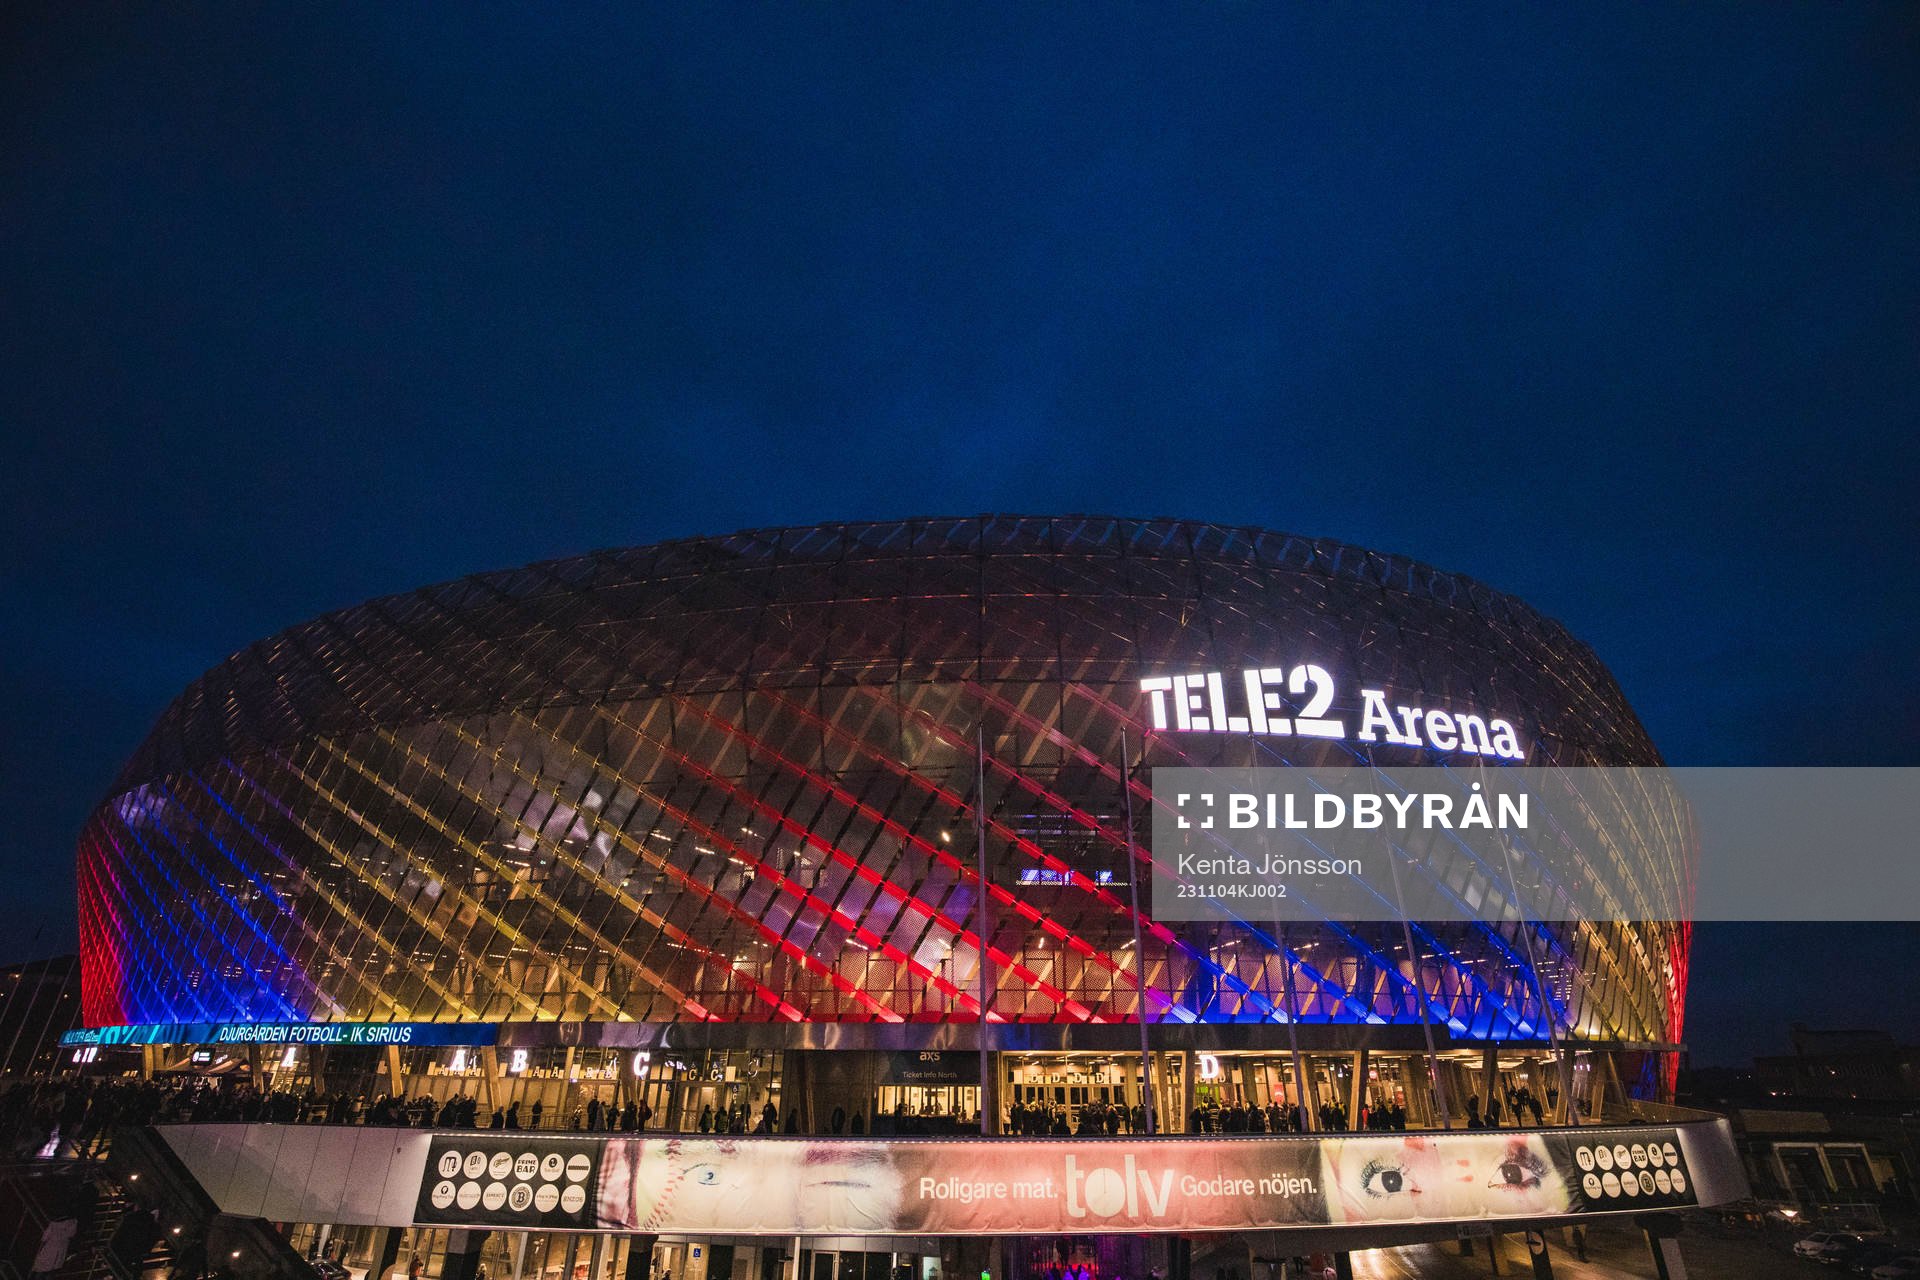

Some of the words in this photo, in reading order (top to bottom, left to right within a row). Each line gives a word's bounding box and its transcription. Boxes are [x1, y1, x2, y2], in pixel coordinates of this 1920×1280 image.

[1141, 664, 1345, 739] TELE2
[1358, 689, 1524, 760] Arena
[219, 1024, 292, 1042] DJURGÅRDEN
[350, 1026, 366, 1042] IK
[366, 1026, 412, 1043] SIRIUS
[449, 1049, 466, 1072] A
[510, 1049, 528, 1073] B
[633, 1051, 651, 1077] C
[919, 1051, 941, 1062] axs
[1199, 1054, 1220, 1079] D
[903, 1071, 921, 1079] Ticket
[923, 1071, 937, 1079] Info
[938, 1071, 958, 1079] North
[516, 1165, 536, 1174] BAR
[919, 1176, 1008, 1204] Roligare
[1012, 1179, 1059, 1199] mat.
[1065, 1153, 1176, 1218] tolv
[1180, 1174, 1256, 1197] Godare
[1258, 1172, 1318, 1199] nöjen.
